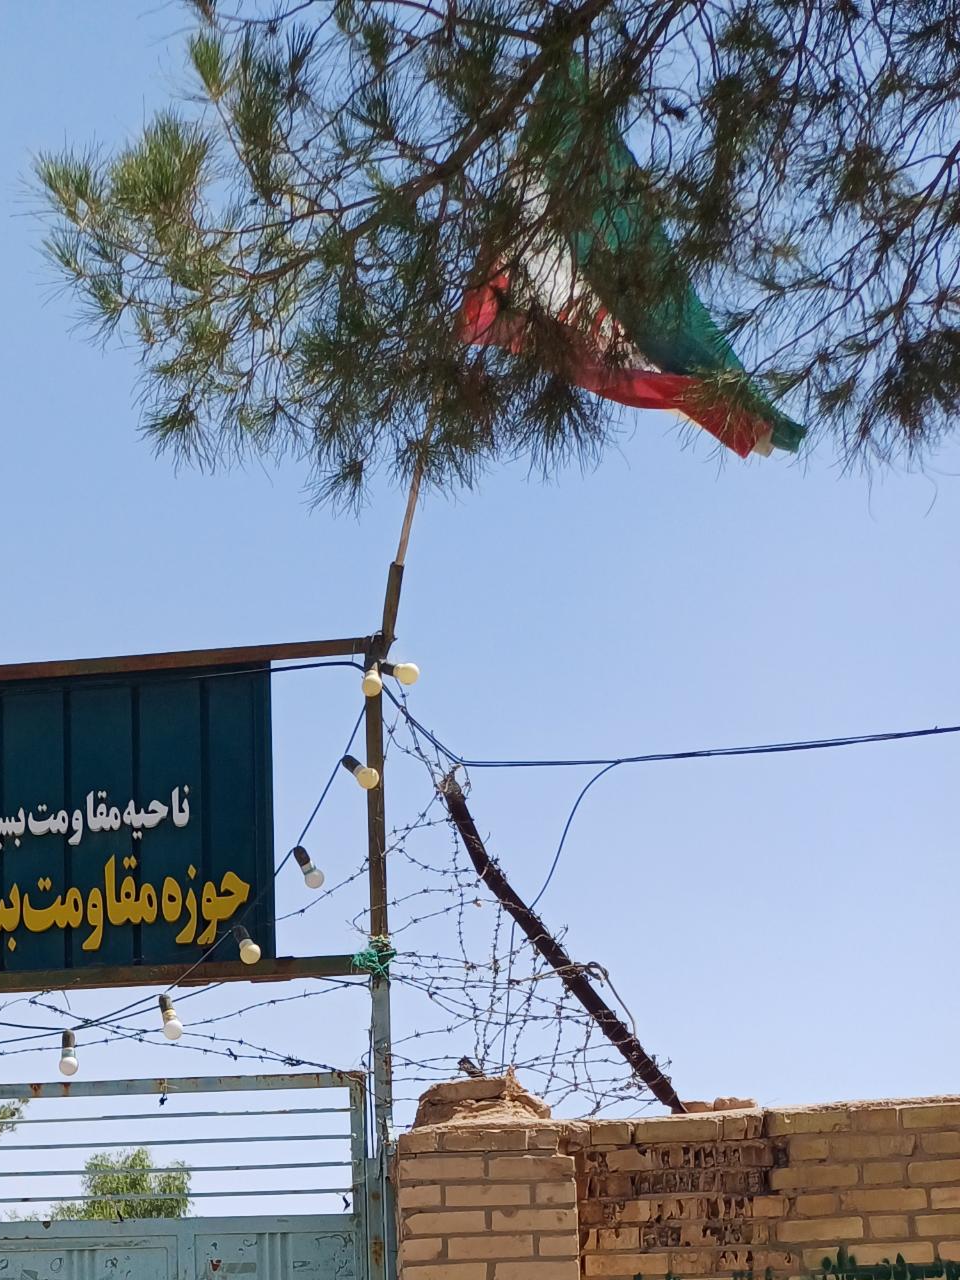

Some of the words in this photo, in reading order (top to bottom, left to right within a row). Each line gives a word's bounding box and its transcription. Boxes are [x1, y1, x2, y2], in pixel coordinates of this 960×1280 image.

[28, 790, 121, 846] مقاومت
[123, 784, 190, 840] ناحیه
[23, 854, 158, 950] مقاومت
[162, 864, 251, 945] حوزه
